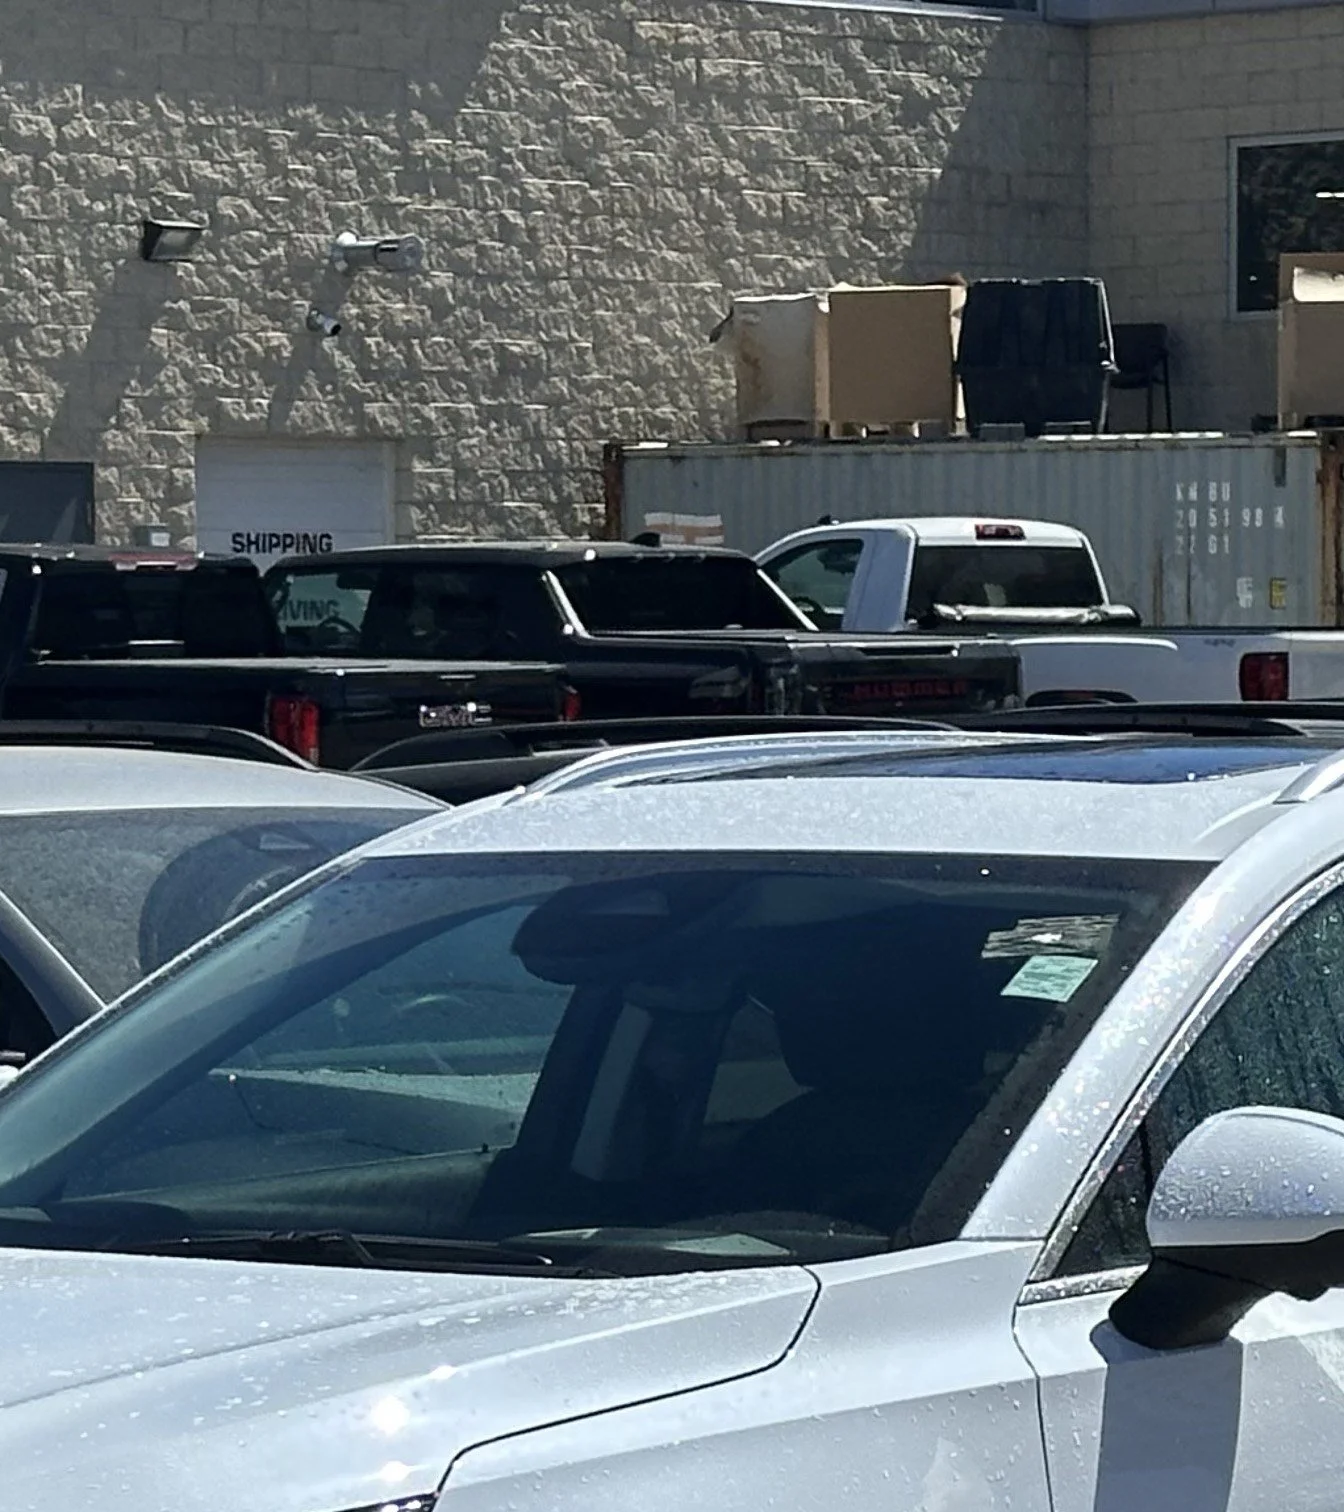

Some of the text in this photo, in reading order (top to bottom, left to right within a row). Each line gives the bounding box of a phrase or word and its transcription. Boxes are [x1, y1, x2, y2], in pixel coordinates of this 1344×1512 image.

[231, 532, 333, 554] SHIPPING
[278, 600, 340, 622] IVING
[419, 703, 493, 727] GMC
